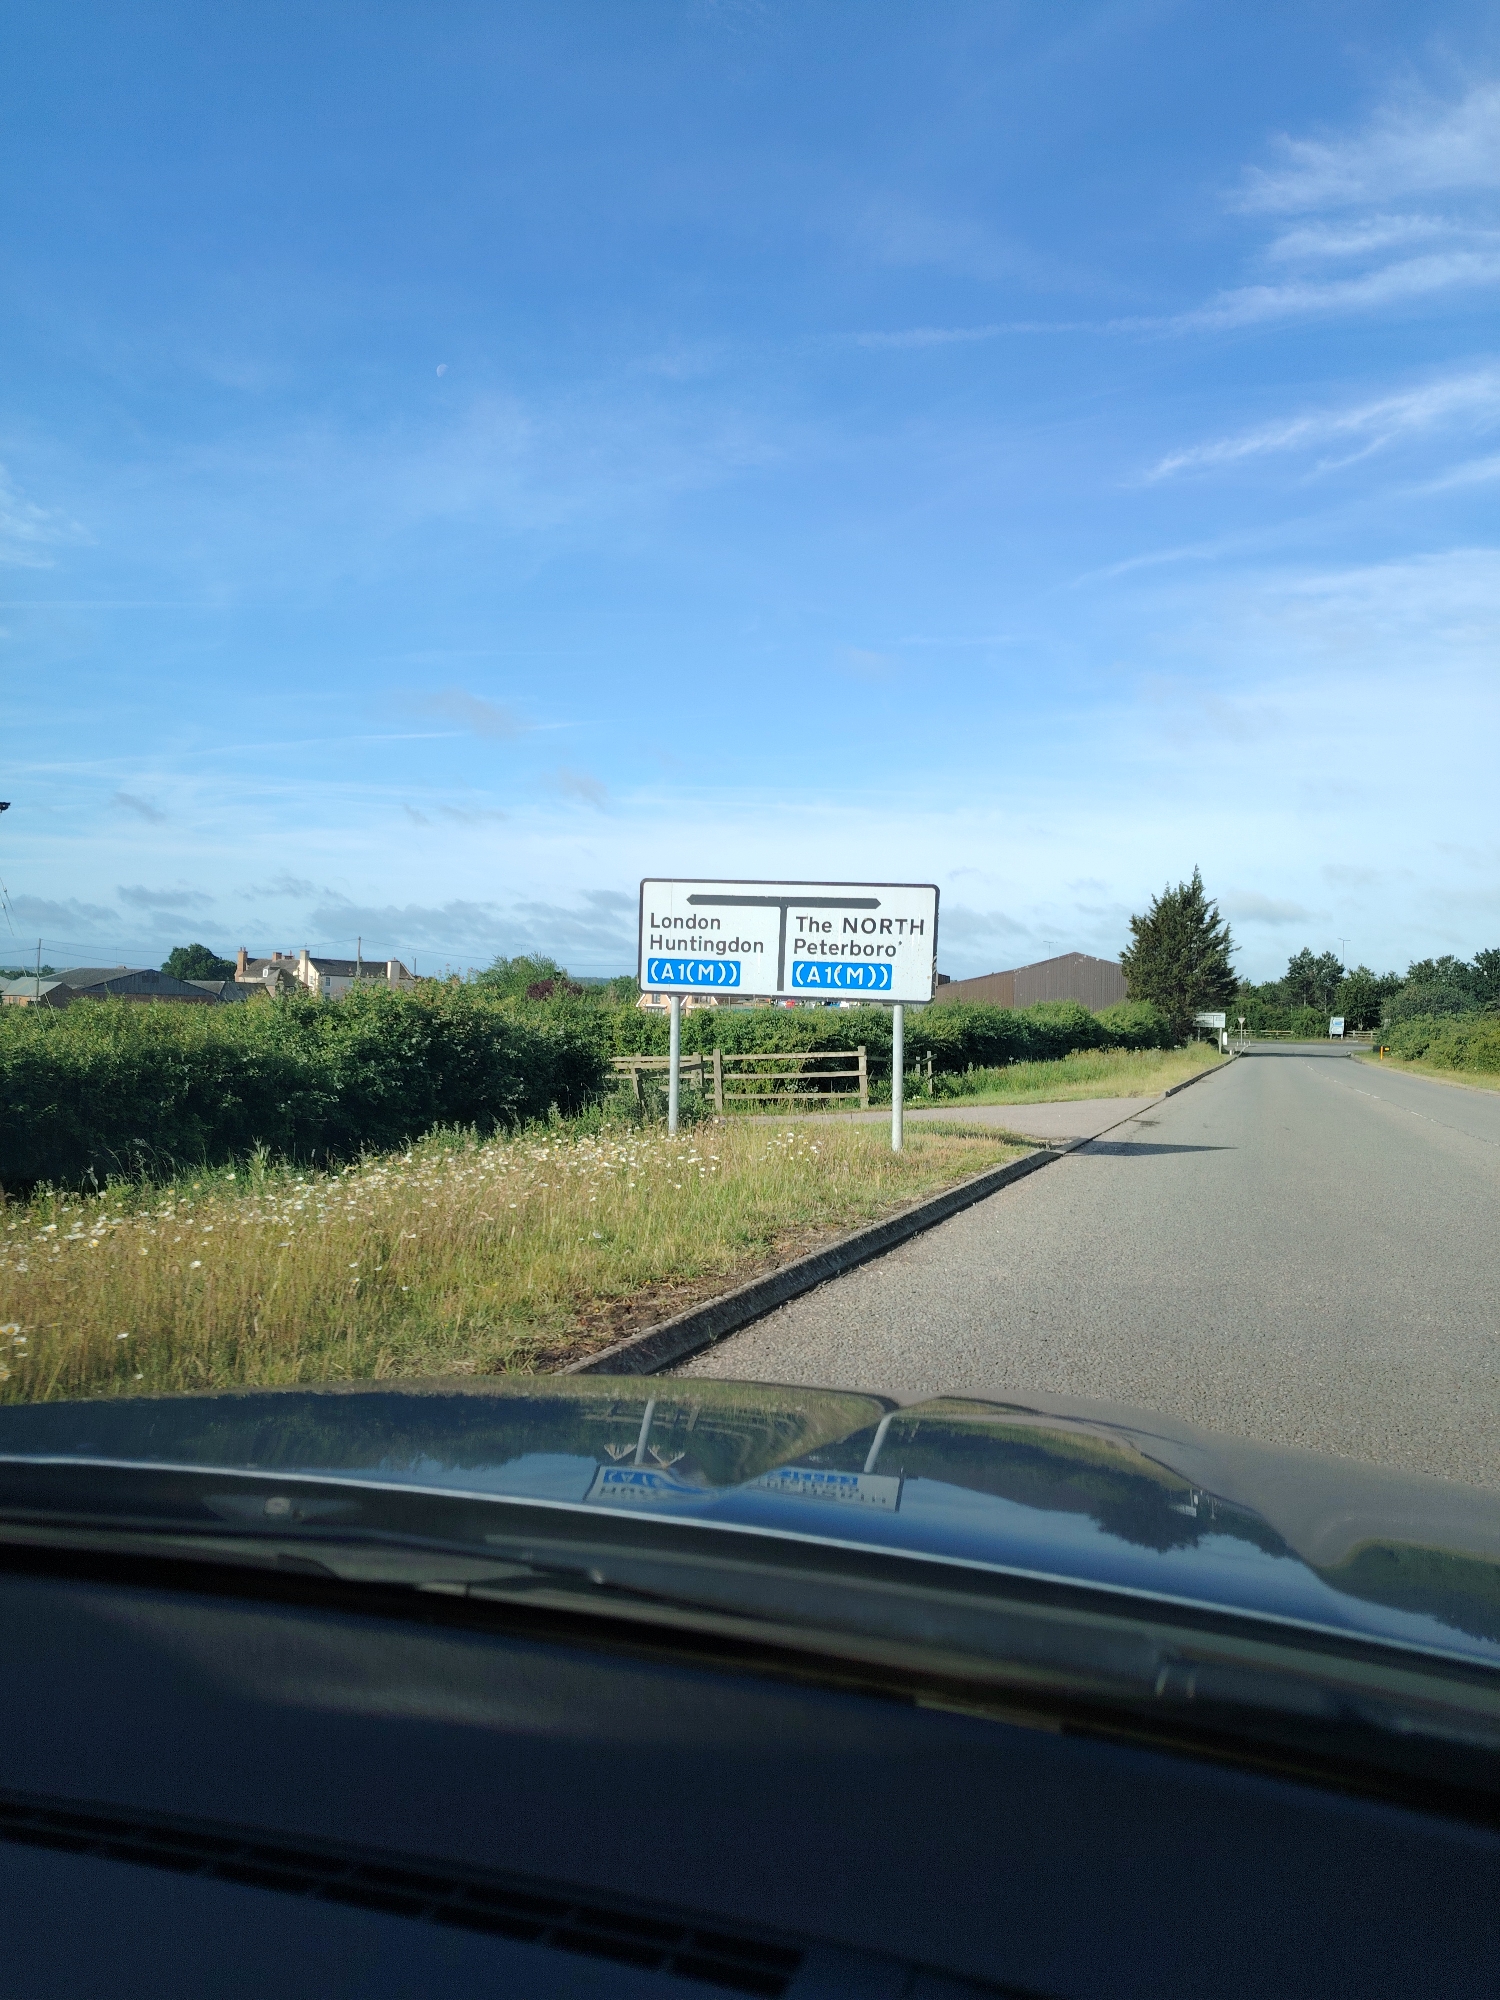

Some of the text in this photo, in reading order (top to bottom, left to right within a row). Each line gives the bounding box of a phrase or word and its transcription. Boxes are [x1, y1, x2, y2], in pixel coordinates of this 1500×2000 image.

[650, 912, 721, 930] London
[795, 916, 924, 935] The NORTH
[649, 934, 764, 955] Huntingdon
[650, 960, 738, 984] (A1(M))
[795, 963, 889, 987] (A1(M))
